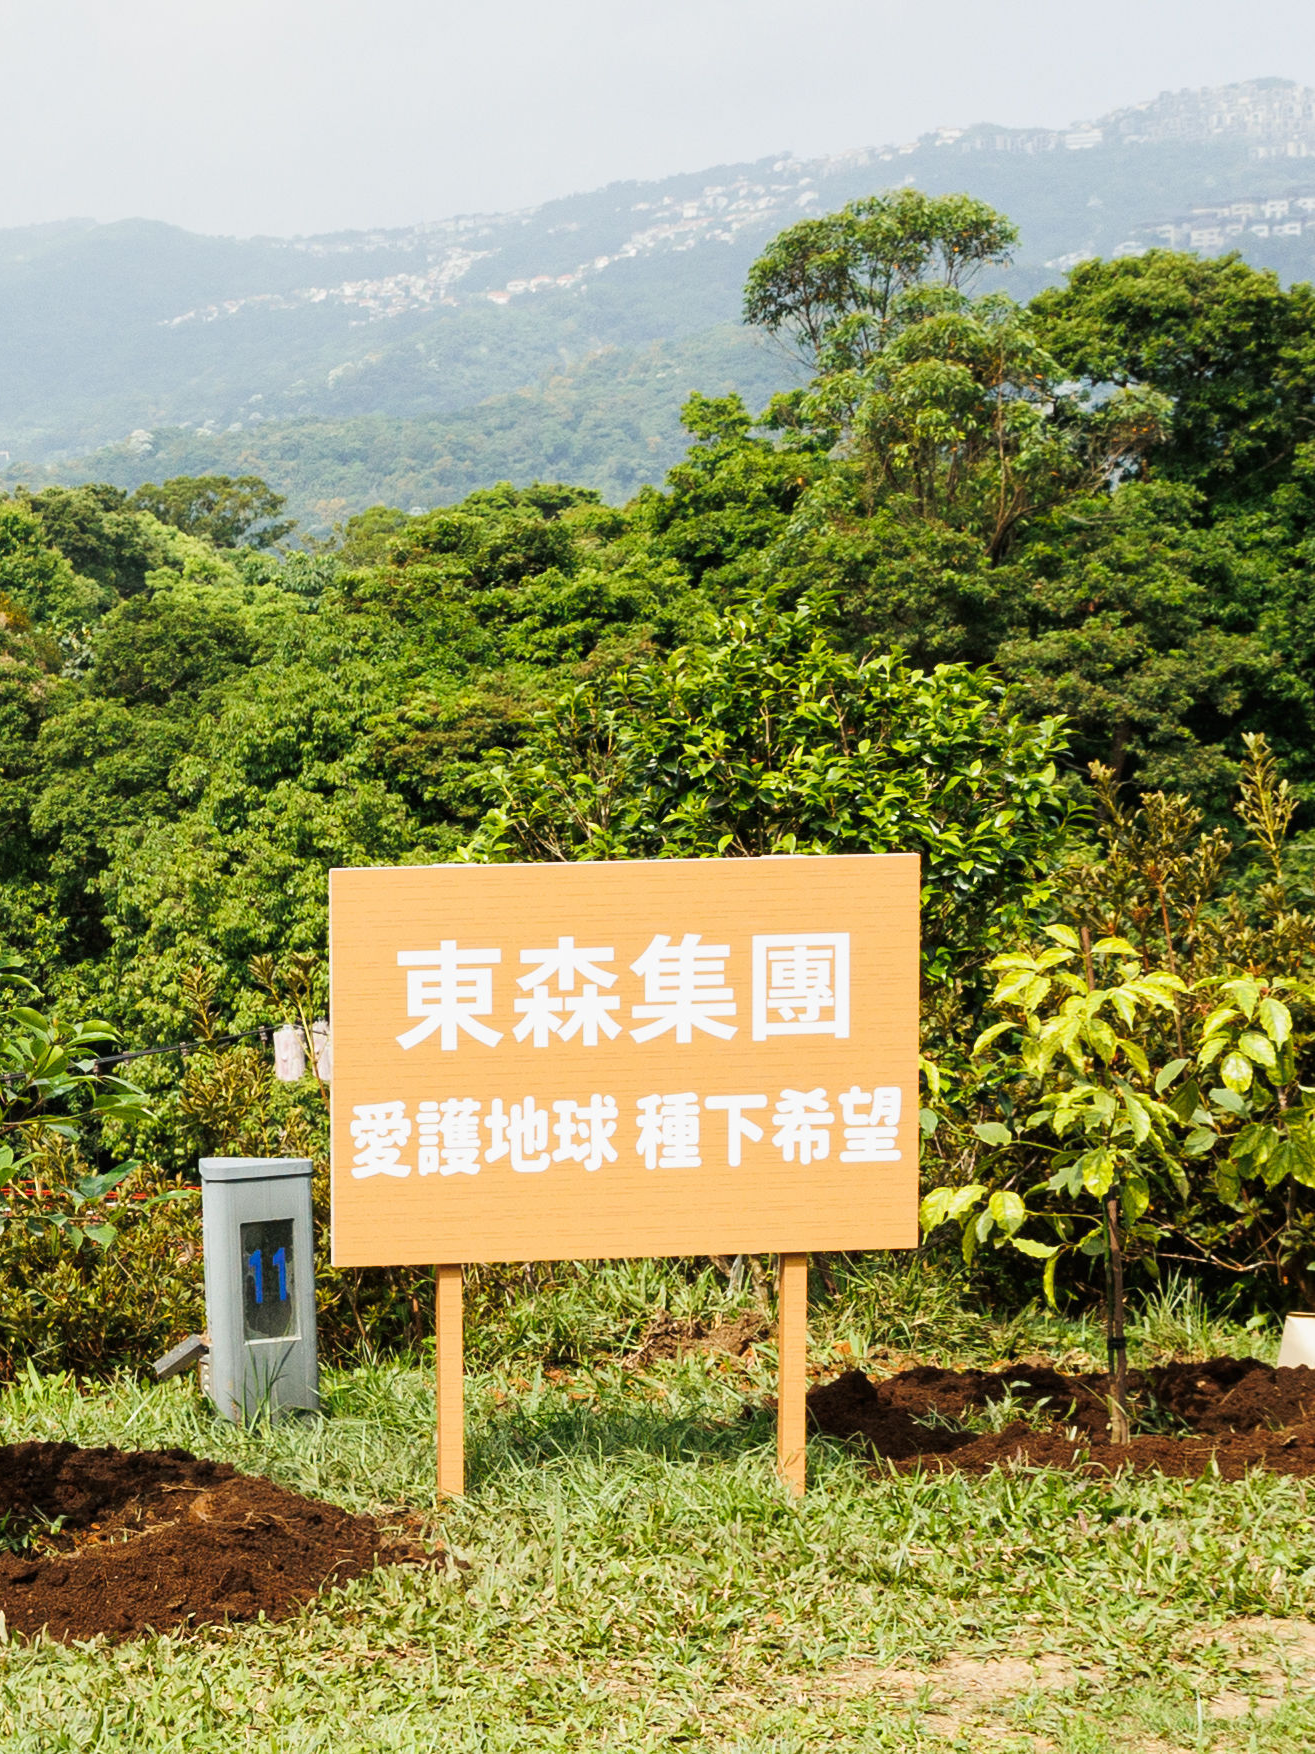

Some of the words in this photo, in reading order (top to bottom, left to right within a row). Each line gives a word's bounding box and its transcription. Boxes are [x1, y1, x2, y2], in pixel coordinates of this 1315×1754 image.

[395, 932, 850, 1051] 東森集團
[349, 1093, 618, 1180] 愛護地球
[636, 1085, 902, 1171] 種下希望
[248, 1247, 288, 1304] 11
